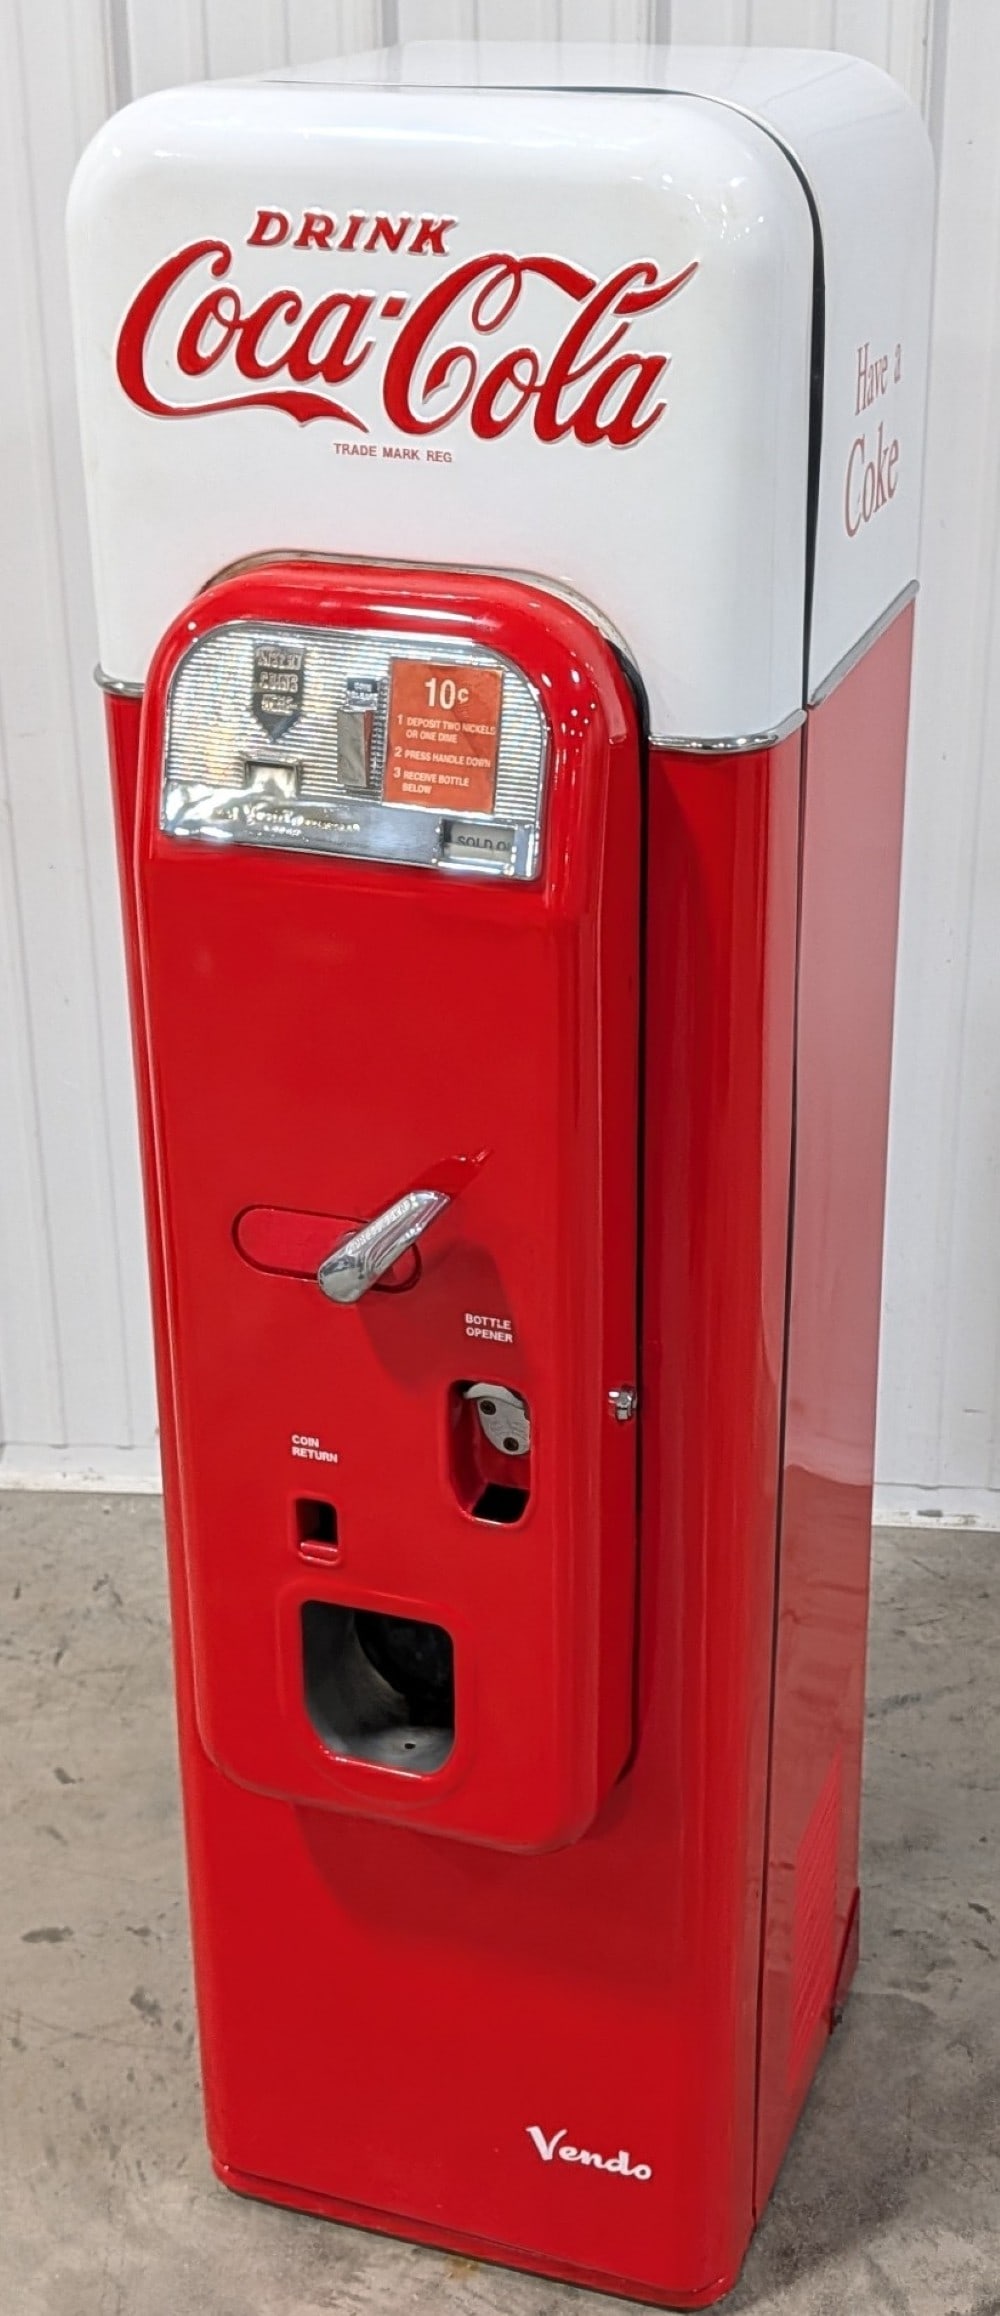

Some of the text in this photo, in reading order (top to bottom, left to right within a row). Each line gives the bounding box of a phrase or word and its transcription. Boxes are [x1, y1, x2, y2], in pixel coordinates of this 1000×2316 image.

[247, 208, 455, 255] DRINK
[116, 239, 700, 449] Coca-Cola
[855, 342, 901, 416] Have a
[334, 443, 453, 462] TRADE MARK REG
[844, 420, 899, 537] Coke
[397, 714, 496, 735] 1 DEPOSIT TWO NICKELS
[405, 729, 458, 743] OR ONE DIME
[394, 746, 491, 768] 2 PRESS HANDLE DOWN
[393, 767, 470, 787] 3 RECEIVE BOTTLE
[402, 784, 432, 795] BELOW
[457, 836, 493, 850] SOLD
[465, 1312, 511, 1330] BOTTLE
[466, 1326, 513, 1343] OPENER
[291, 1434, 320, 1448] COIN
[291, 1446, 338, 1463] RETURN
[525, 2125, 652, 2180] Vendo
